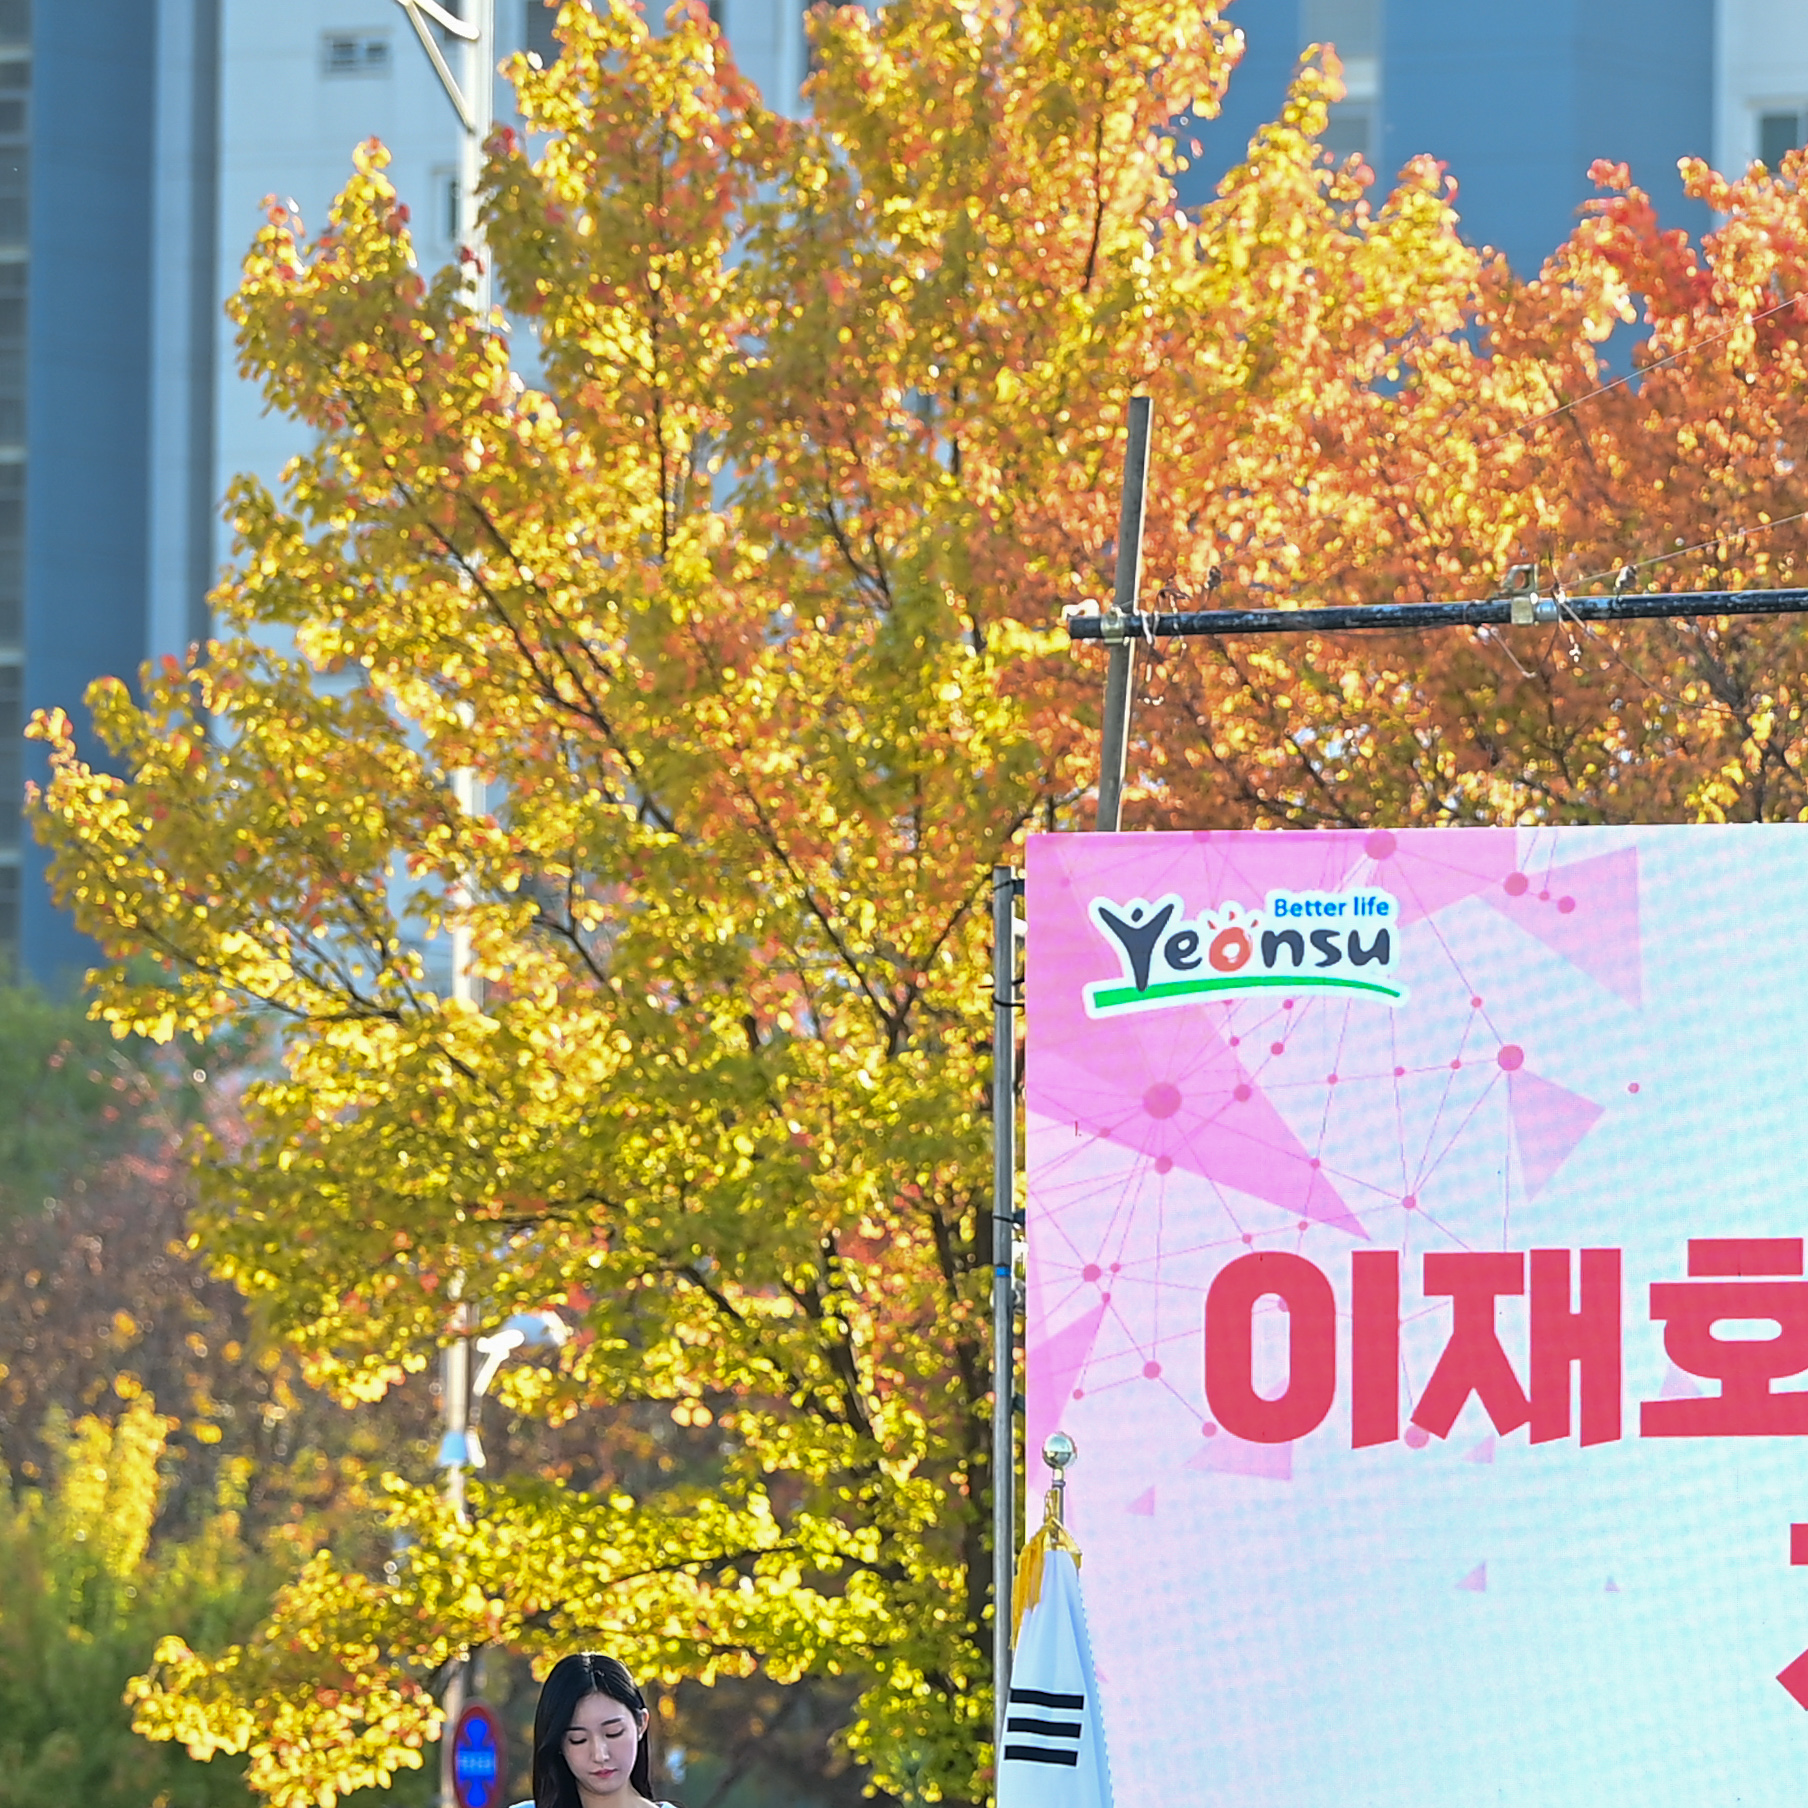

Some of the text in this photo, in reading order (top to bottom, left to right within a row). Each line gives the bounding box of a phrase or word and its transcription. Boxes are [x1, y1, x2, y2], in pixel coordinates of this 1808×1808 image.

[1275, 896, 1389, 918] Better life
[1099, 903, 1390, 992] Yeonsu
